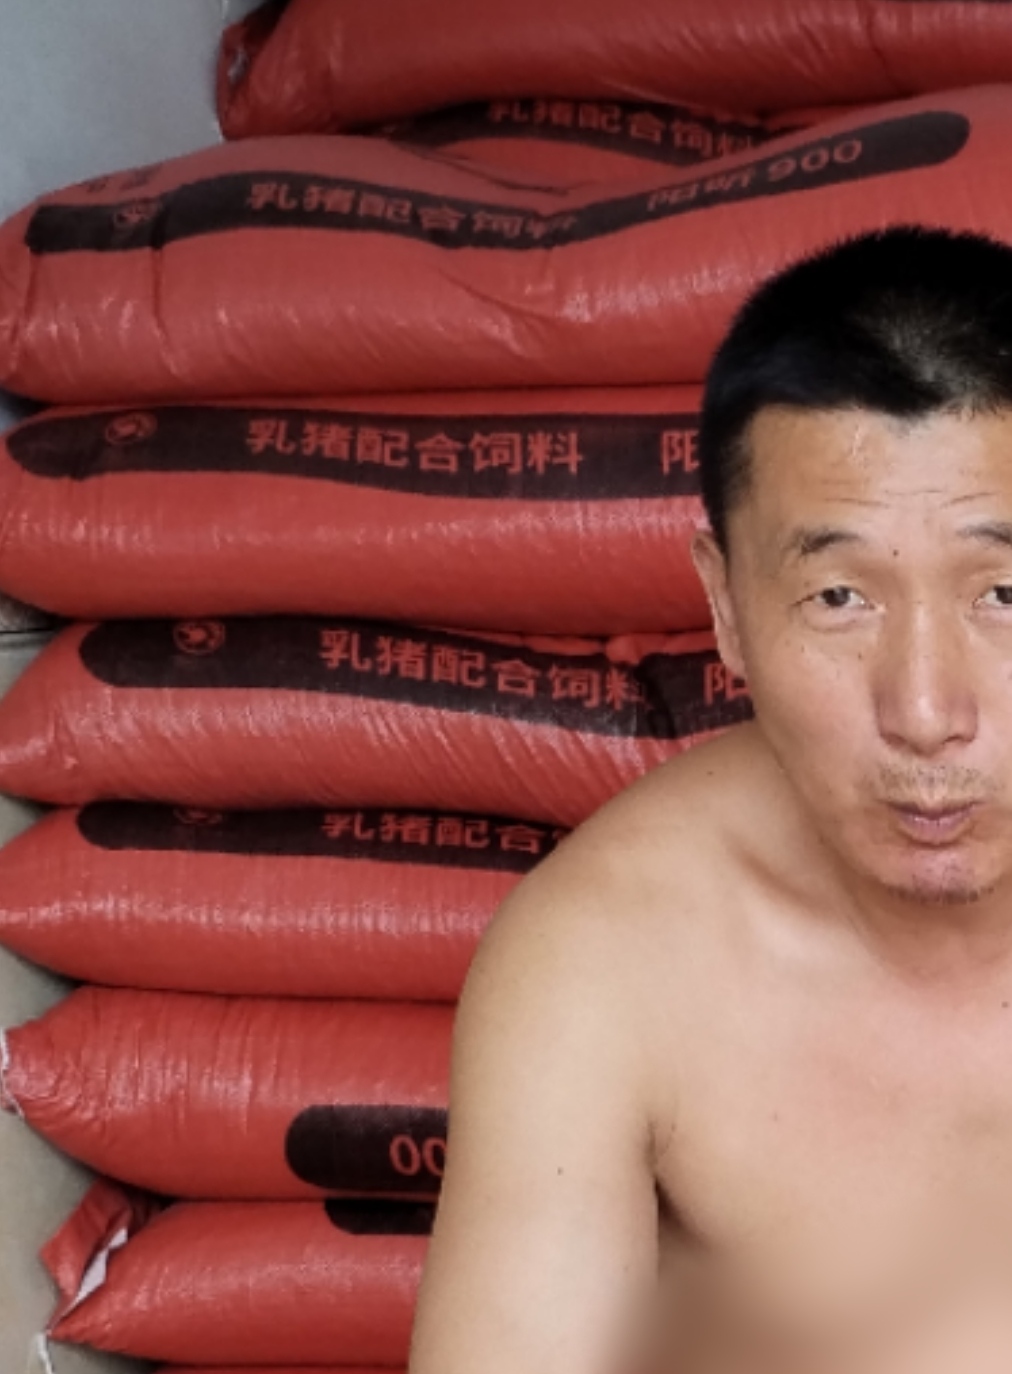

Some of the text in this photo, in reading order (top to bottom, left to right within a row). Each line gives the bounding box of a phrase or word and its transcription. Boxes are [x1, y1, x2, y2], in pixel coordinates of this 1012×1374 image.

[768, 140, 862, 181] 900
[246, 418, 583, 475] 乳猪配合饲料
[321, 811, 566, 854] 乳猪配合
